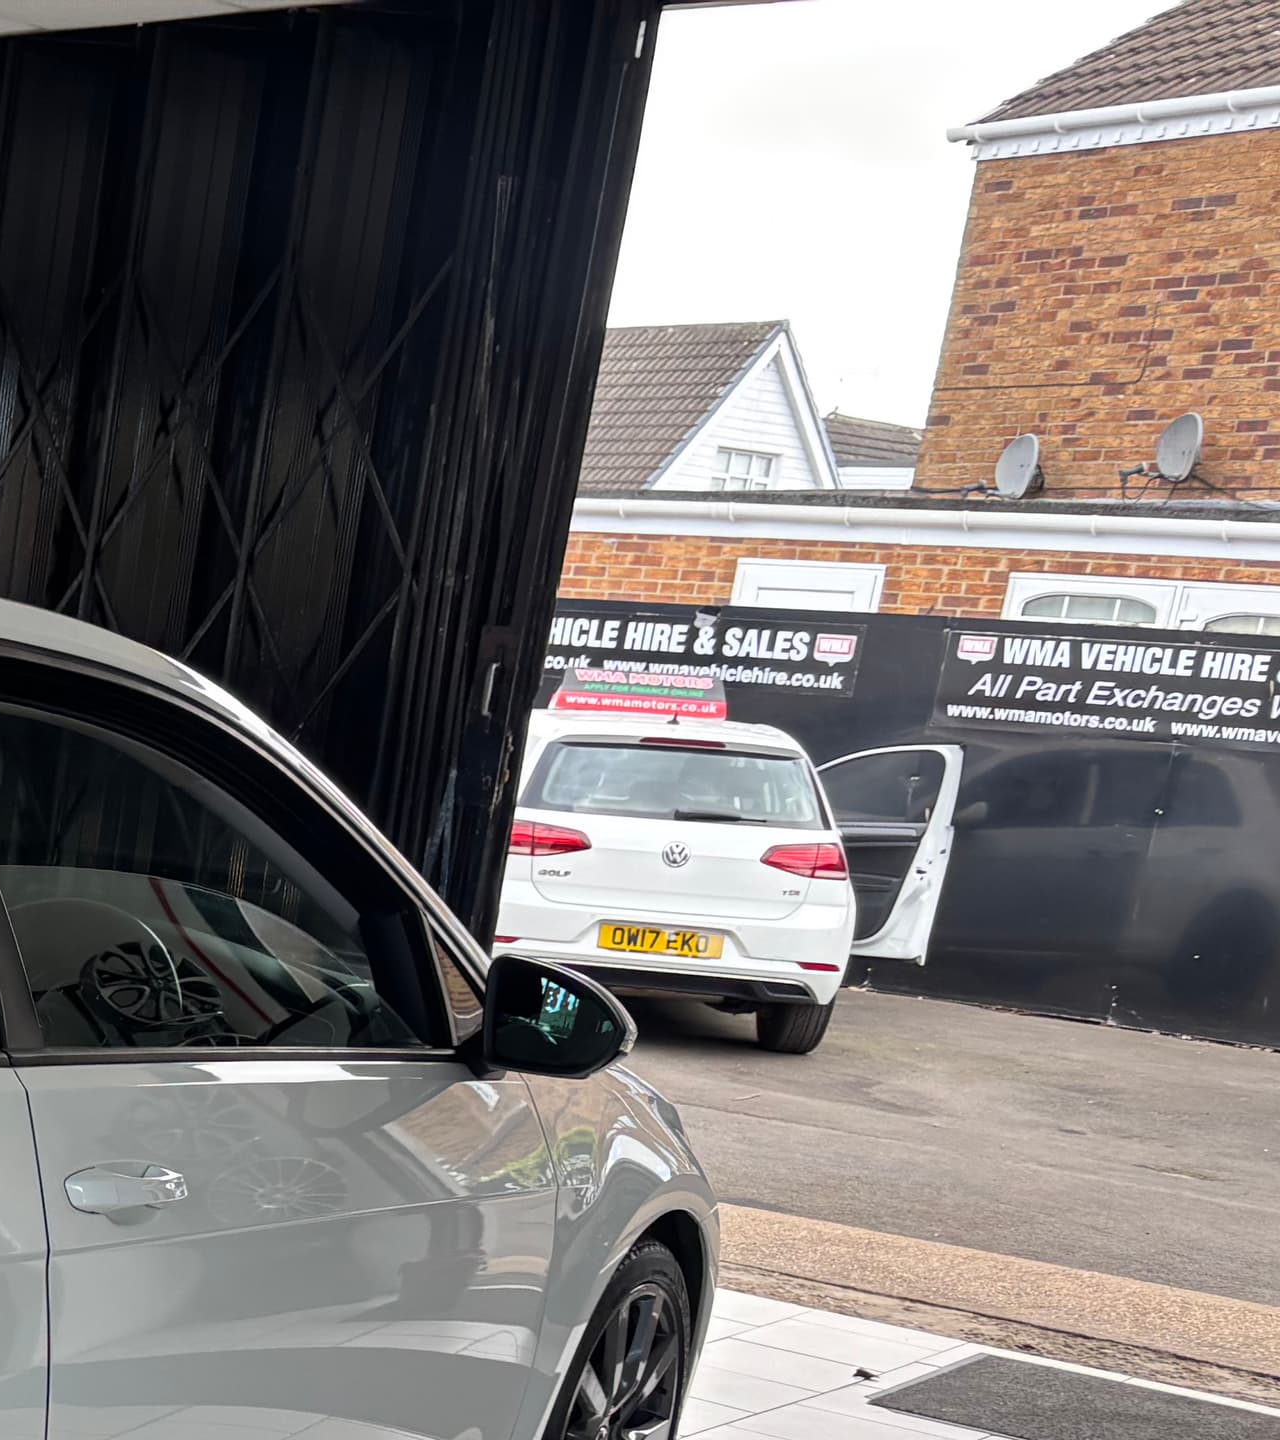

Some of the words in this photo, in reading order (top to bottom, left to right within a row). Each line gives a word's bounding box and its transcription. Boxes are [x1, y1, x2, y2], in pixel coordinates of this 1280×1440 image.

[623, 621, 690, 653] HIRE
[693, 626, 717, 655] &
[722, 627, 811, 661] SALES
[1002, 637, 1072, 669] WMA
[1081, 643, 1198, 678] VEHICLE
[1200, 651, 1272, 682] HIRE
[575, 669, 627, 684] WMA
[629, 673, 714, 690] MOTORS
[565, 694, 717, 713] www.wmamotors.co.uk
[967, 673, 1013, 699] All
[1015, 675, 1083, 704] Part
[1085, 680, 1263, 720] Exchanges
[946, 702, 1160, 733] www.wmamotors.co.uk
[612, 927, 660, 947] OW17
